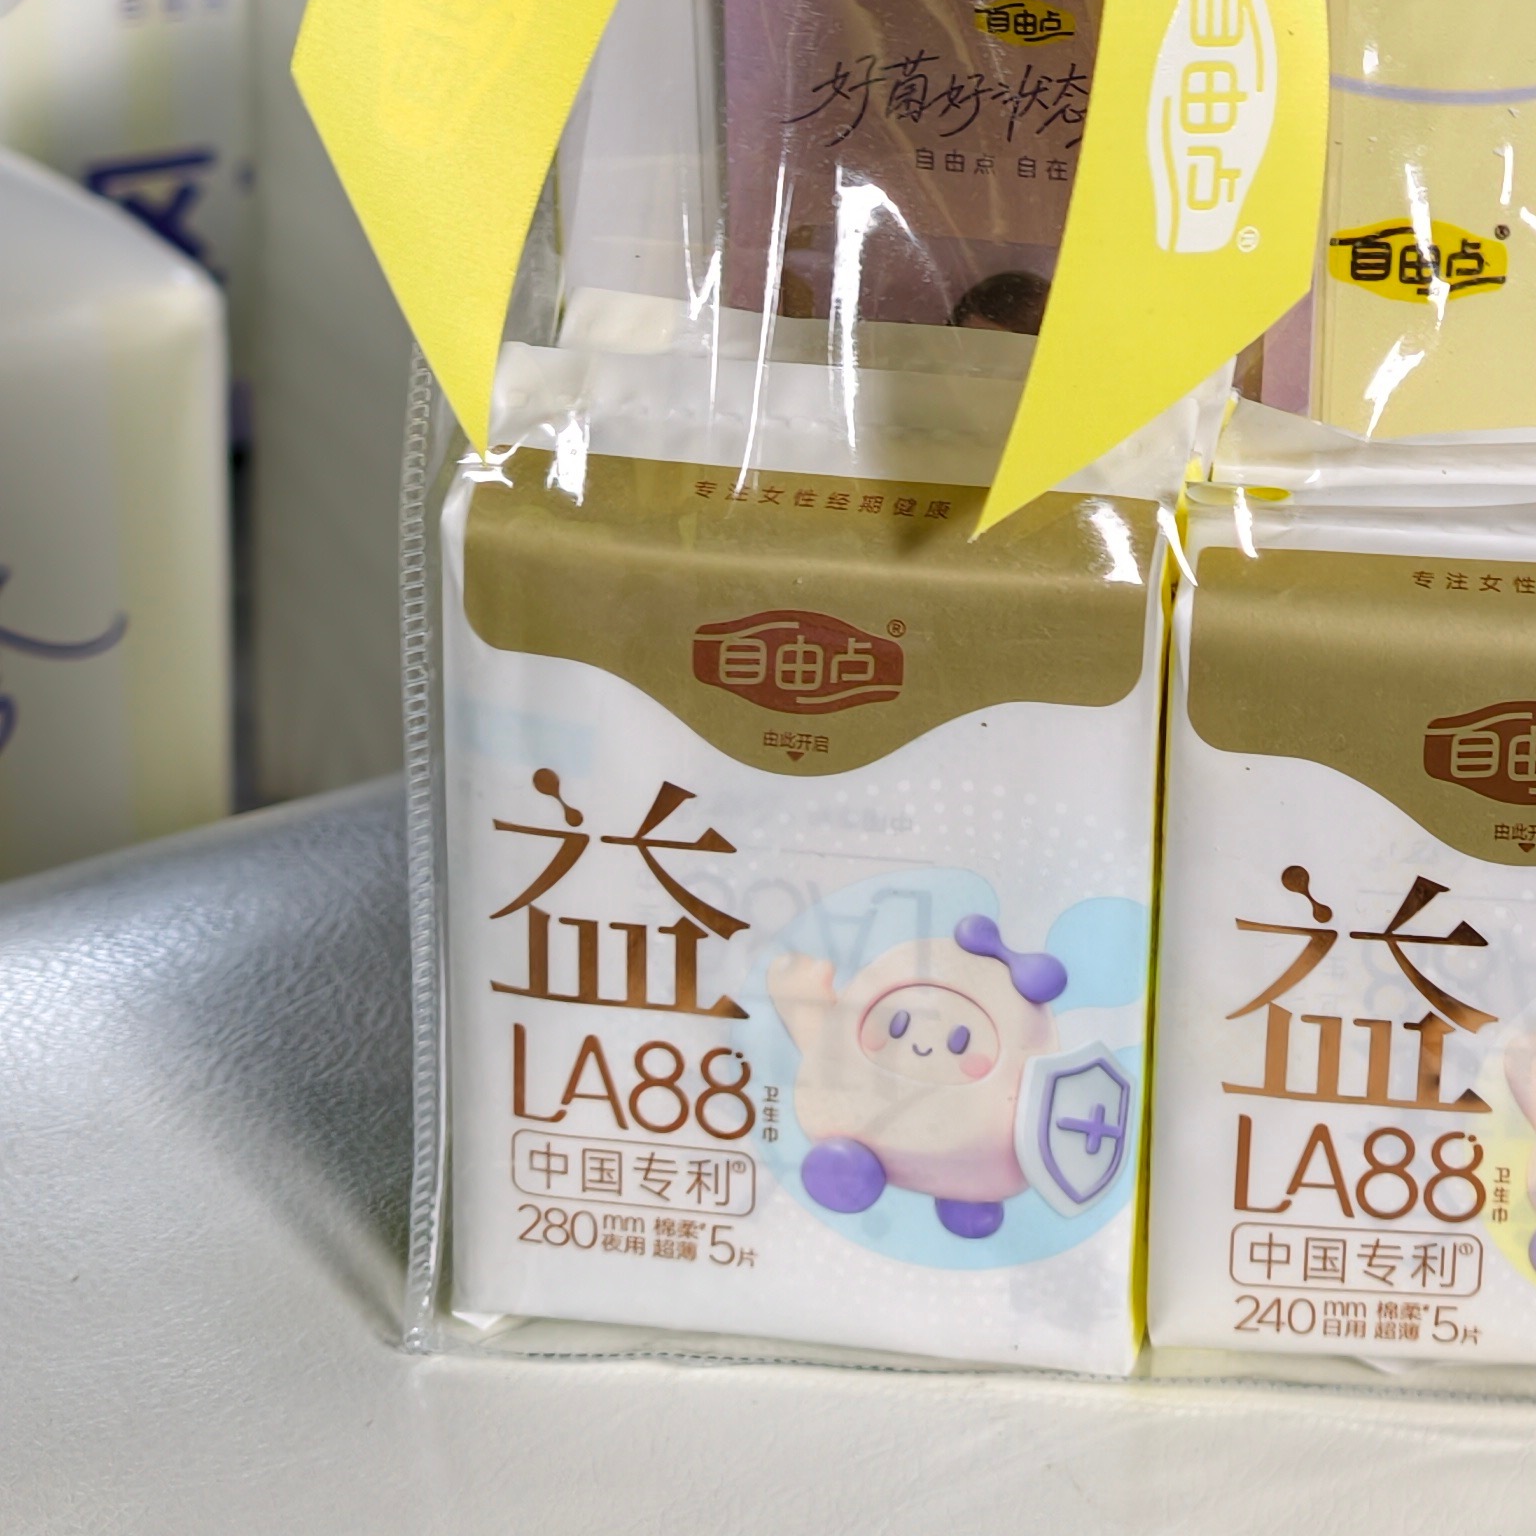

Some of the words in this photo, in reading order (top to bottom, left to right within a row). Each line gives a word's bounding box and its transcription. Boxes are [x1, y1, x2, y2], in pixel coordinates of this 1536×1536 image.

[986, 9, 1062, 36] 自由点
[779, 49, 1088, 149] 好菌好状态
[915, 147, 996, 175] 自由点
[1350, 238, 1488, 285] 自由点
[718, 634, 876, 692] 自由点
[763, 729, 829, 754] 由此开启
[489, 767, 751, 1020] 益
[1221, 864, 1500, 1114] 益
[513, 1022, 757, 1141] LA88
[762, 1085, 779, 1144] 卫生巾
[1233, 1113, 1488, 1224] LA88
[1491, 1166, 1511, 1225] 卫生巾
[517, 1202, 599, 1251] 280
[602, 1214, 646, 1234] mm
[601, 1233, 646, 1256] 夜用
[652, 1239, 699, 1262] 超薄
[1233, 1294, 1318, 1336] 240
[1323, 1299, 1368, 1318] mm
[1322, 1318, 1367, 1340] 日用
[1373, 1321, 1421, 1342] 超薄
